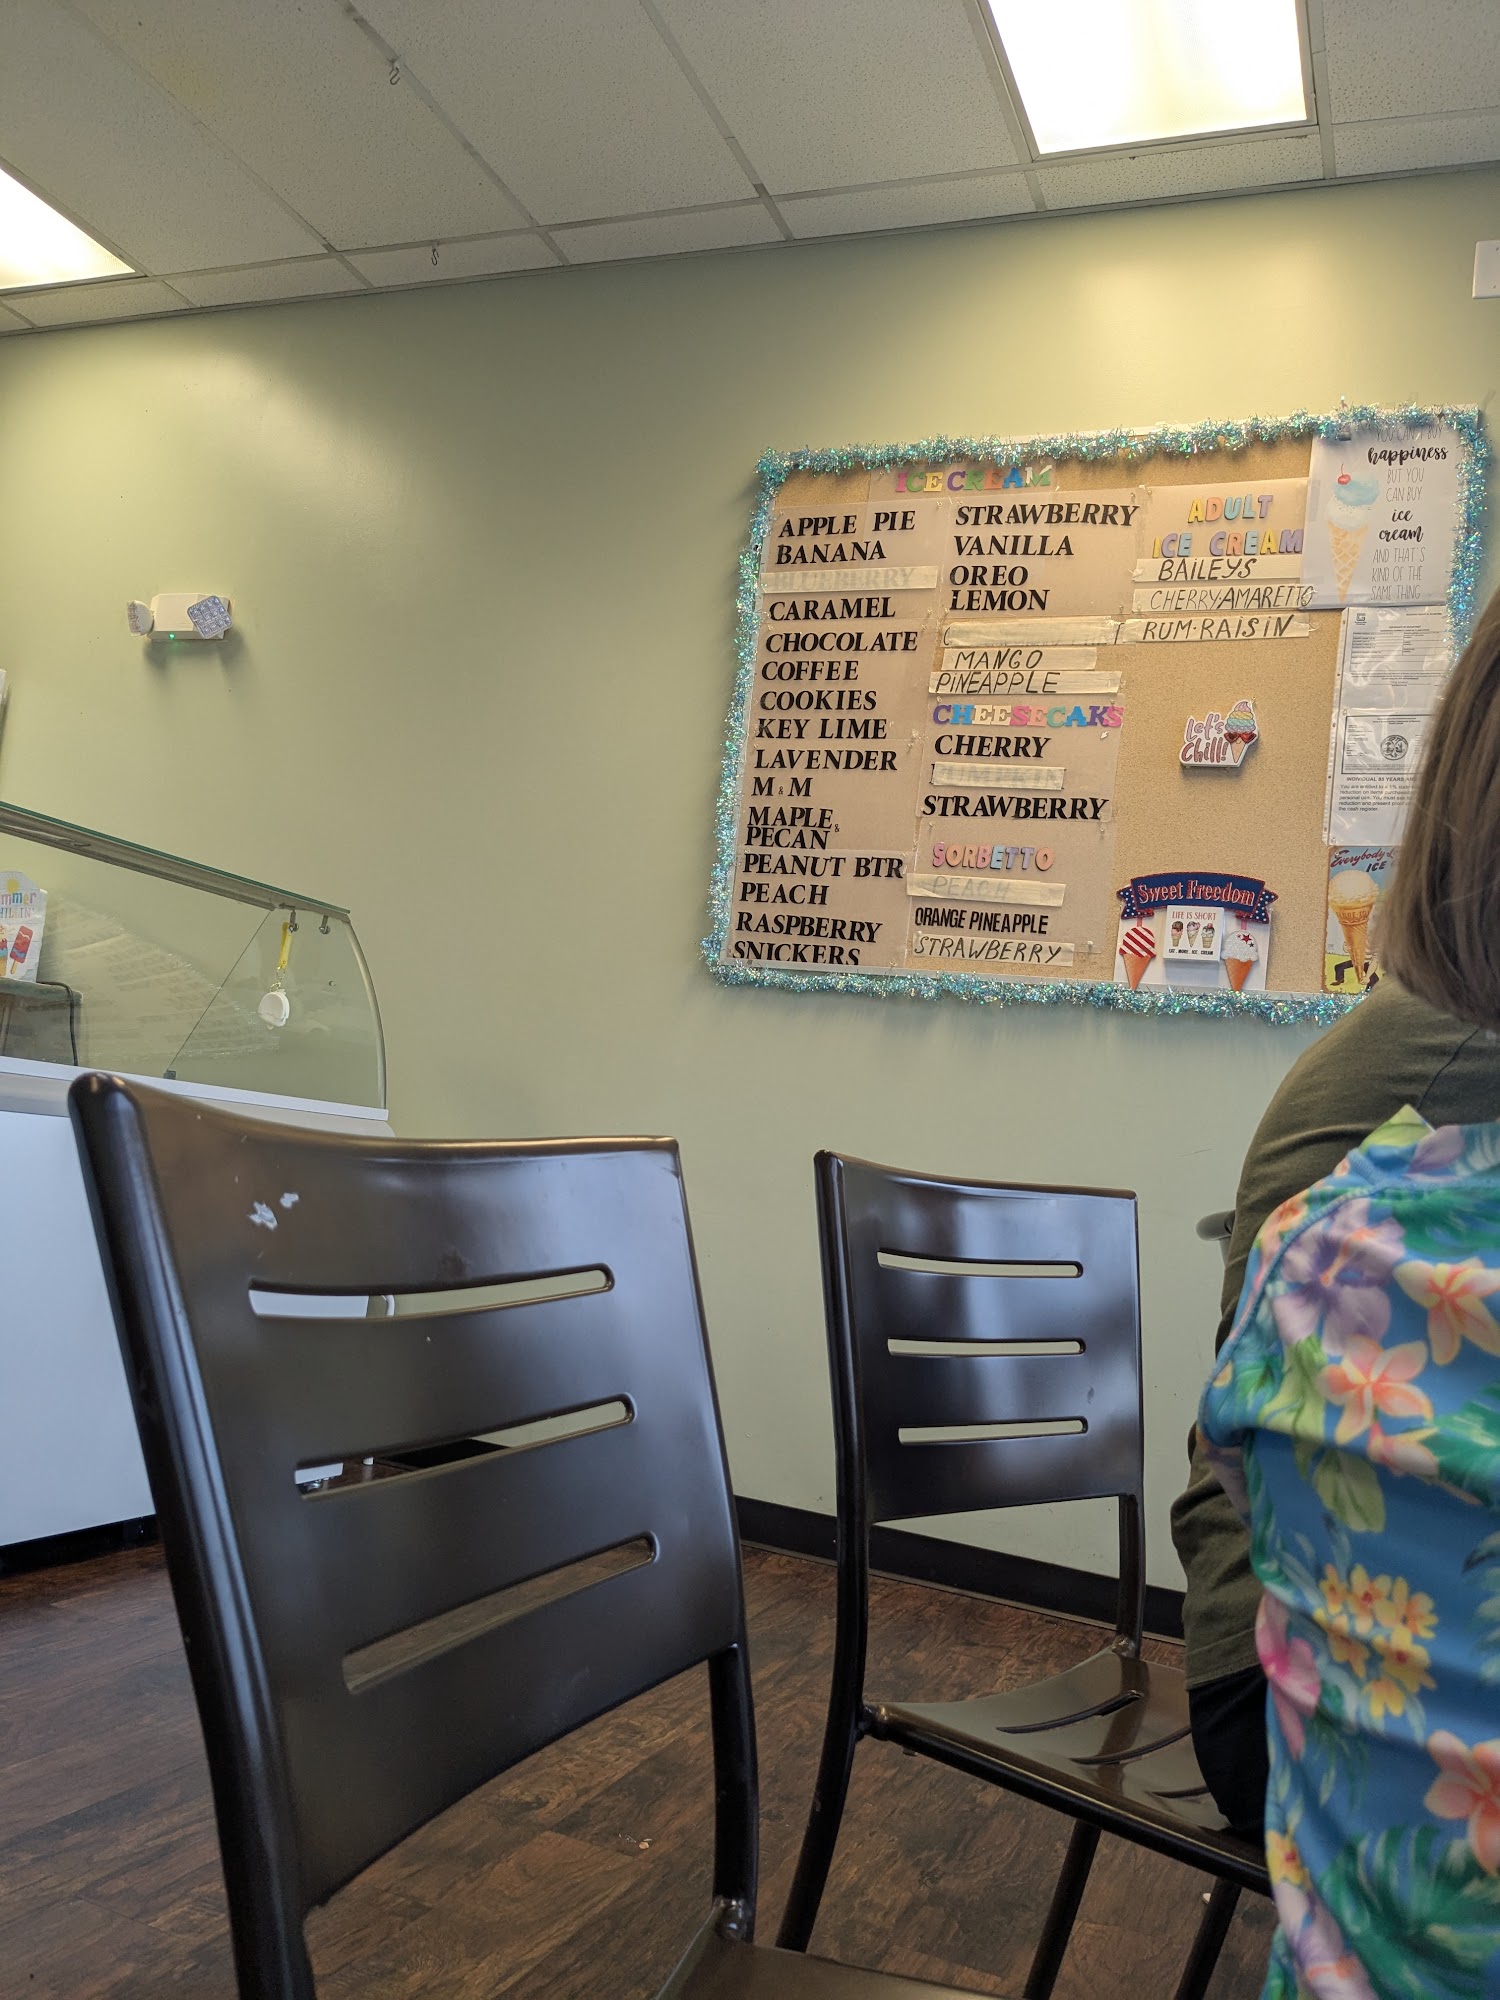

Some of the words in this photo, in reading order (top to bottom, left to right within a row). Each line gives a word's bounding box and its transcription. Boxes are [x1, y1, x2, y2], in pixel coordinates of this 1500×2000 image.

[1368, 446, 1449, 466] happiness
[896, 472, 943, 492] ICE
[947, 465, 1052, 491] CREAM
[1387, 468, 1402, 484] BUT
[1407, 467, 1425, 483] YOU
[1386, 487, 1404, 502] CAN
[1407, 486, 1422, 501] BUY
[955, 503, 1140, 526] STRAWBERRY
[1188, 494, 1273, 523] ADULT
[1392, 509, 1413, 522] ice
[778, 515, 857, 537] APPLE
[872, 511, 916, 532] PIE
[1379, 526, 1424, 542] cream
[775, 540, 886, 564] BANANA
[953, 535, 1074, 556] VANILLA
[1152, 532, 1192, 558] ICE
[1209, 528, 1304, 556] CREAM
[1373, 549, 1389, 563] AND
[1394, 547, 1426, 562] THAT'S
[950, 566, 1028, 586] OREO
[1372, 567, 1390, 582] KIND
[1393, 566, 1404, 582] OF
[1408, 566, 1423, 581] THE
[950, 589, 1050, 611] LEMON
[1371, 585, 1392, 600] SAME
[1397, 585, 1421, 600] THING
[769, 597, 896, 621] CARAMEL
[766, 631, 918, 652] CHOCOLATE
[955, 648, 1043, 669] MANGO
[762, 660, 859, 681] COFFEE
[760, 690, 877, 711] COOKIES
[933, 704, 1124, 727] CHEESECAKS
[756, 718, 811, 739] KEY
[818, 719, 887, 739] LIME
[1186, 713, 1224, 742] Let's
[935, 734, 1052, 758] CHERRY
[1181, 736, 1229, 763] Chill!
[754, 749, 897, 771] LAVENDER
[747, 806, 833, 829] MAPLE
[922, 795, 1109, 819] STRAWBERRY
[745, 827, 831, 850] PECAN
[743, 853, 846, 877] PEANUT
[853, 856, 904, 879] BTR
[932, 841, 1054, 871] SORBETTO
[1366, 860, 1388, 873] ICE
[739, 882, 830, 906] PEACH
[1138, 881, 1184, 904] Sweet
[1186, 879, 1256, 907] Freedom
[915, 907, 967, 929] ORANGE
[969, 911, 1049, 934] PINEAPPLE
[1172, 911, 1184, 919] LIFE
[1186, 911, 1193, 919] IS
[1194, 911, 1217, 920] SHORT
[736, 911, 883, 944] RASPBERRY
[732, 941, 861, 966] SNICKERS
[914, 936, 1062, 964] STRAWBERRY
